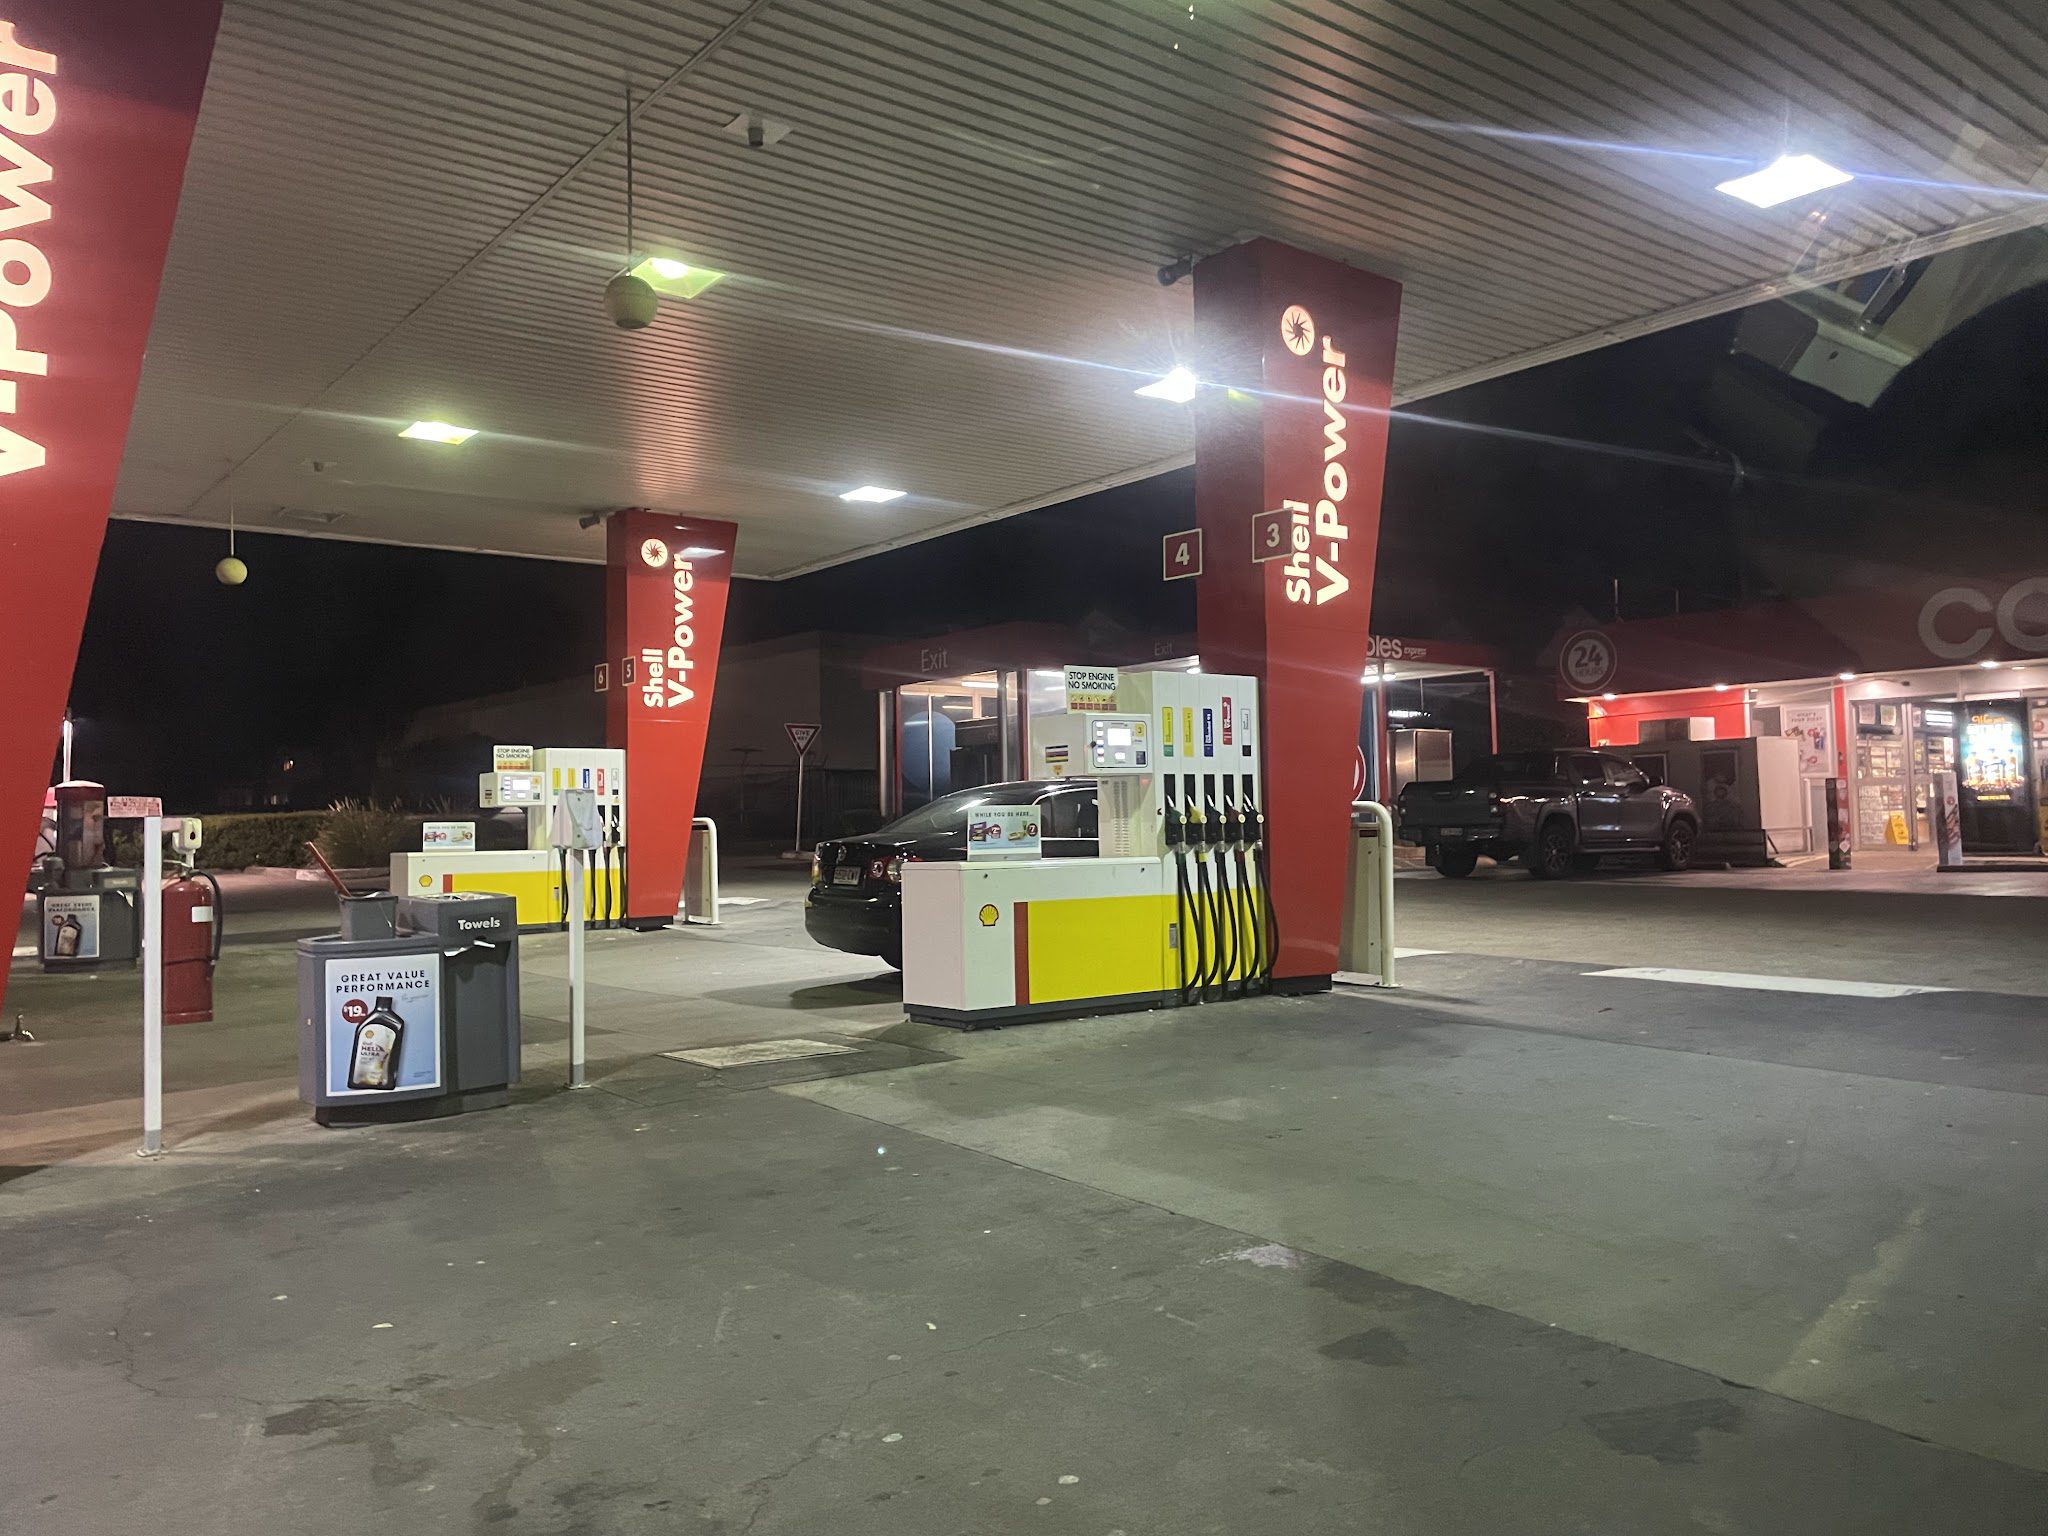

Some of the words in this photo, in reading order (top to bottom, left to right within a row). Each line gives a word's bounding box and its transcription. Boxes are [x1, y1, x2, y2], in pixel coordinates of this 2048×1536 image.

[1315, 335, 1350, 606] V-Power
[1266, 523, 1281, 548] 3
[1175, 542, 1190, 565] 4
[1283, 499, 1311, 605] Shell
[667, 553, 695, 708] V-Power
[1154, 641, 1173, 657] Exit
[1366, 634, 1402, 659] oles
[1573, 644, 1603, 668] 24
[626, 664, 632, 679] 5
[921, 648, 949, 672] Exit
[598, 670, 604, 684] 6
[641, 648, 664, 708] Shell
[1068, 681, 1080, 689] NO
[1082, 681, 1116, 691] SMOKING
[1069, 671, 1087, 680] STOP
[1088, 672, 1115, 681] ENGINE
[457, 916, 501, 931] Towels
[336, 979, 431, 993] PERFORMANCE
[341, 973, 381, 983] GREAT
[387, 969, 425, 980] VALUE
